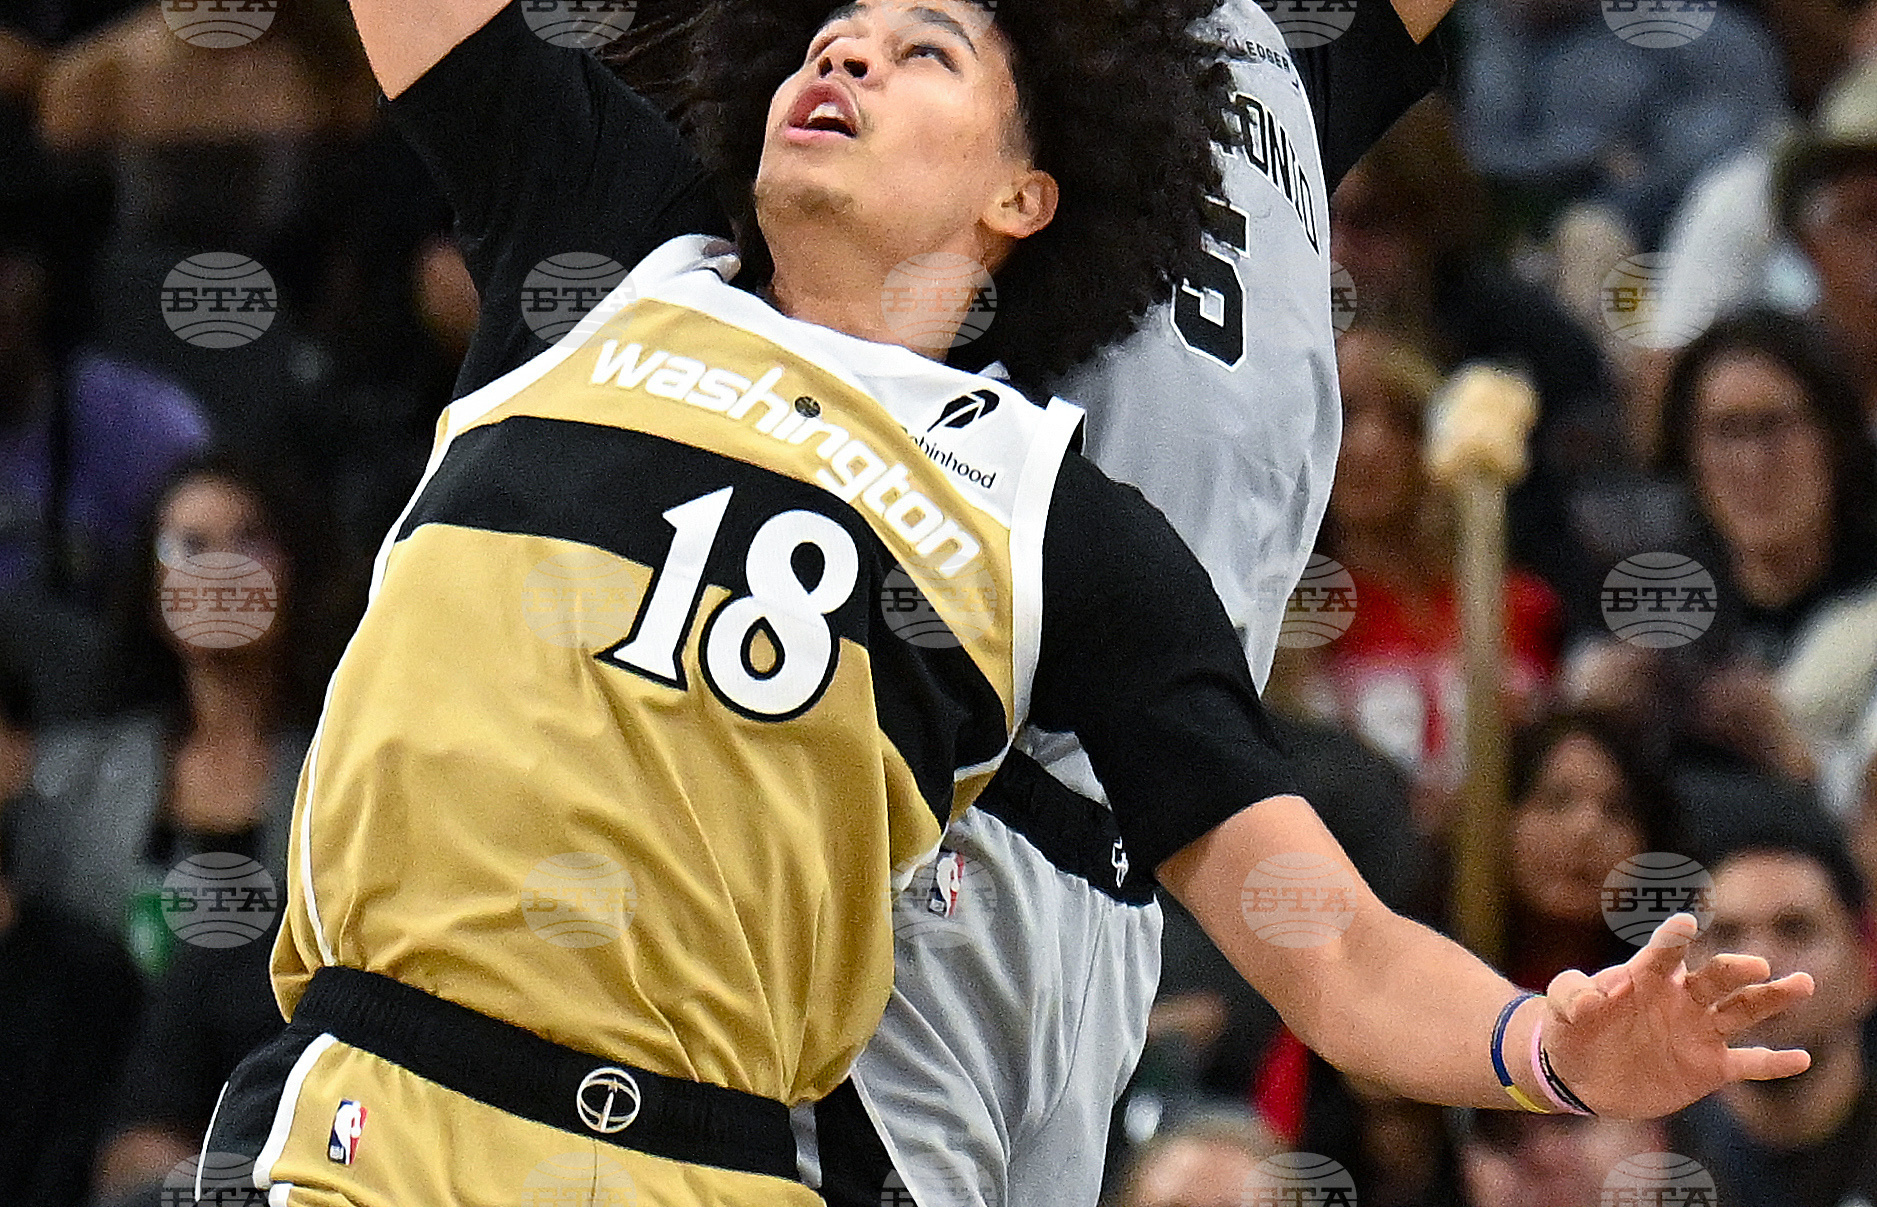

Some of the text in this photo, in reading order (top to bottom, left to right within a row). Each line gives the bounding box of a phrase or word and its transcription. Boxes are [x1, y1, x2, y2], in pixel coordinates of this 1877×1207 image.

[1212, 93, 1321, 260] ONIO
[589, 338, 981, 579] washington
[900, 425, 998, 490] binhood
[594, 485, 859, 723] 18
